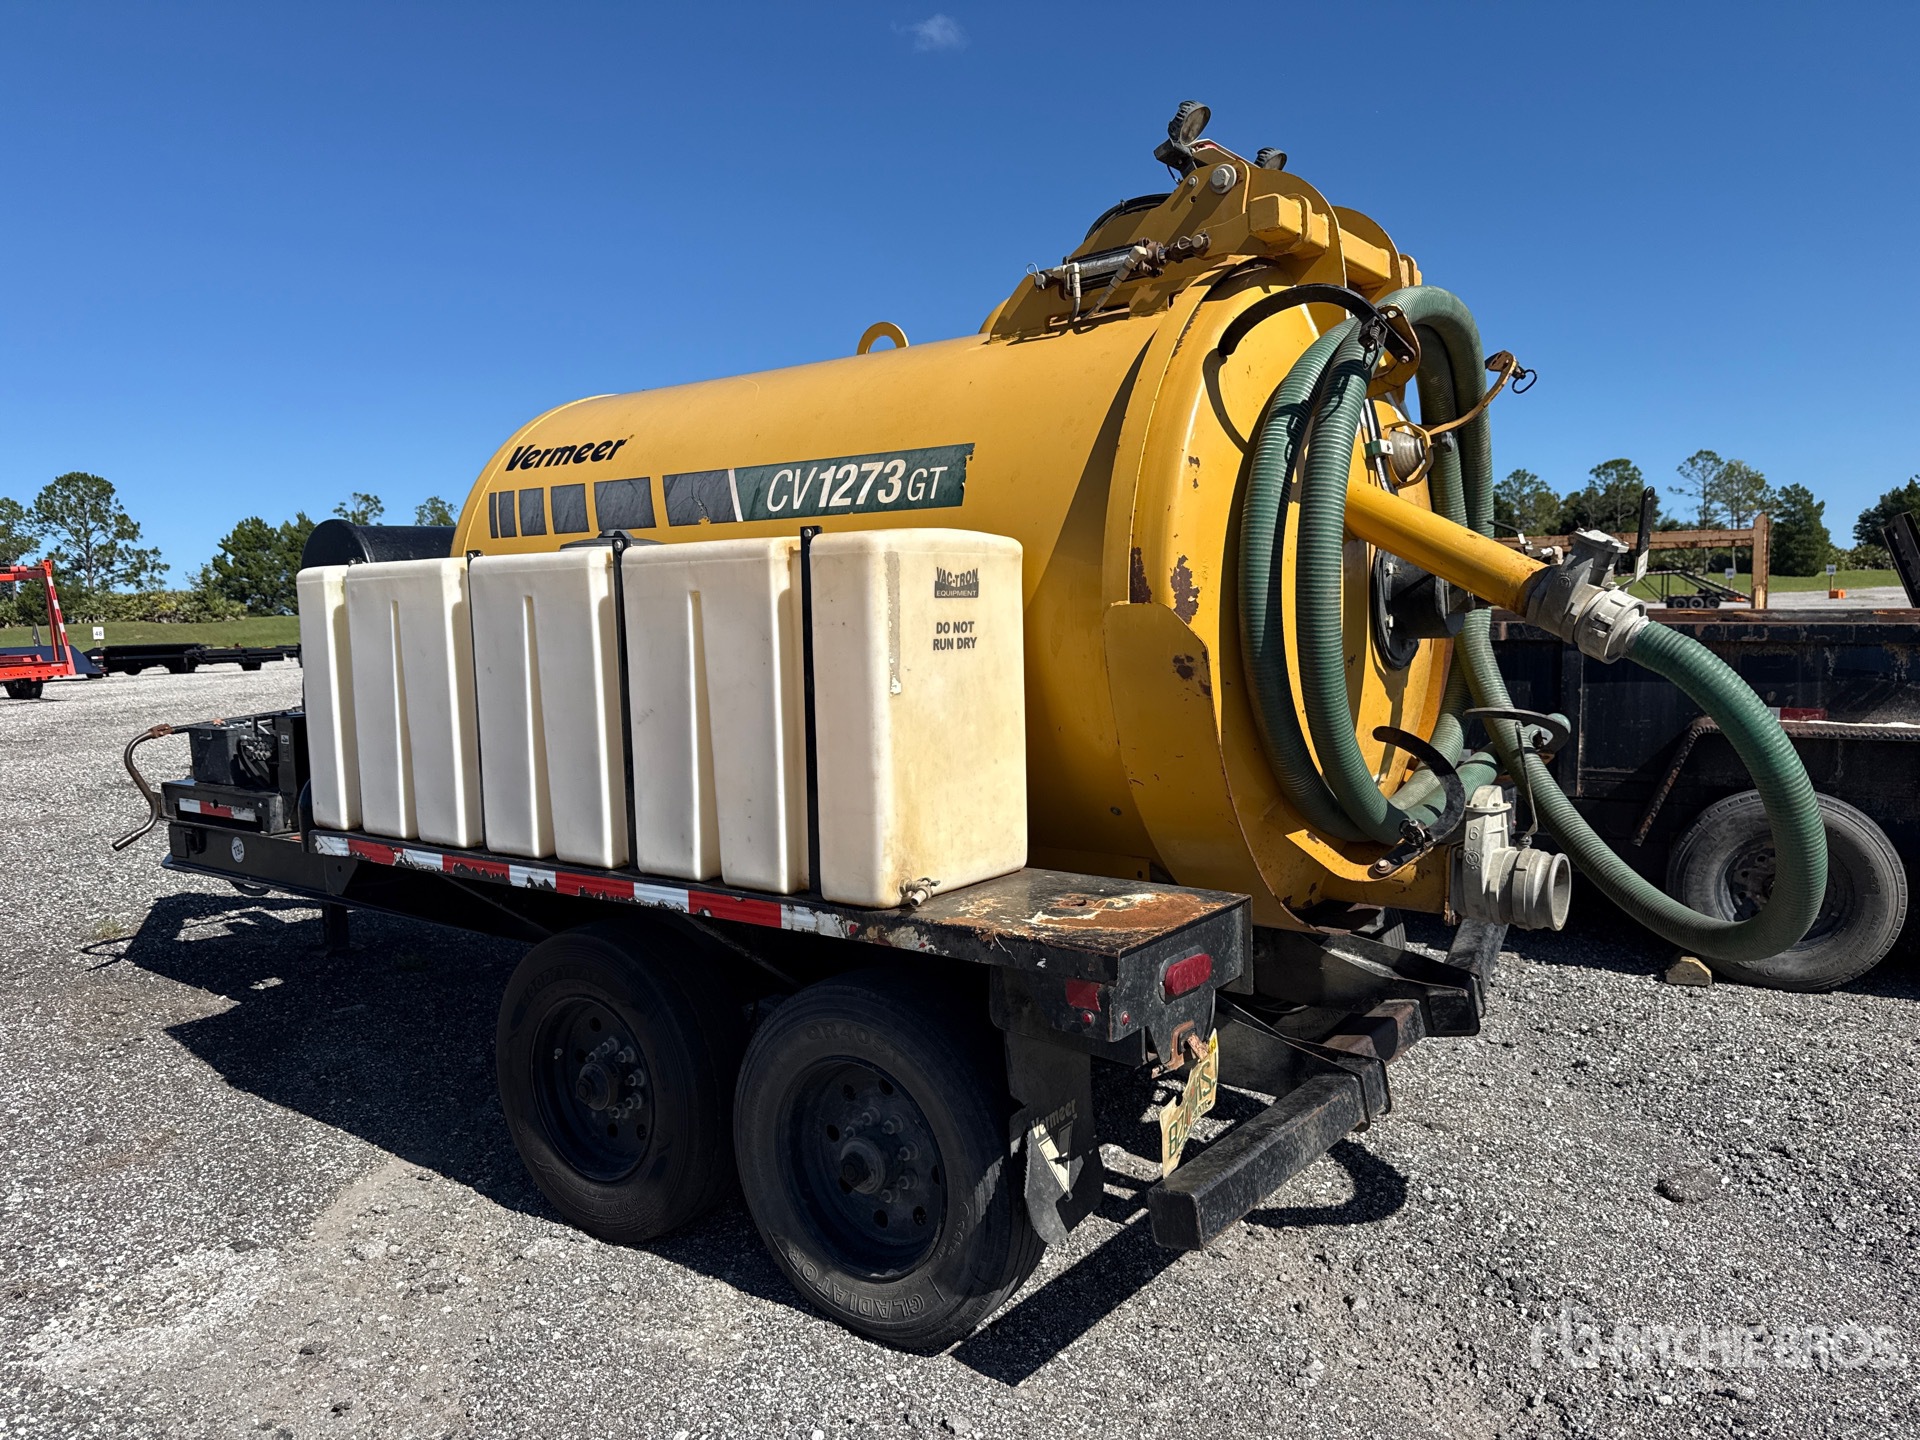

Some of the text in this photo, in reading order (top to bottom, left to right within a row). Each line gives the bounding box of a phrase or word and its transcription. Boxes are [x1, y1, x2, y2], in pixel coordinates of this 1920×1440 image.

[505, 438, 629, 472] Vermeer
[936, 620, 975, 634] DO NOT
[933, 637, 977, 651] RUN DRY
[1469, 826, 1479, 840] 6
[1031, 1098, 1076, 1139] Vermeer
[787, 1245, 924, 1319] GLADIATOR
